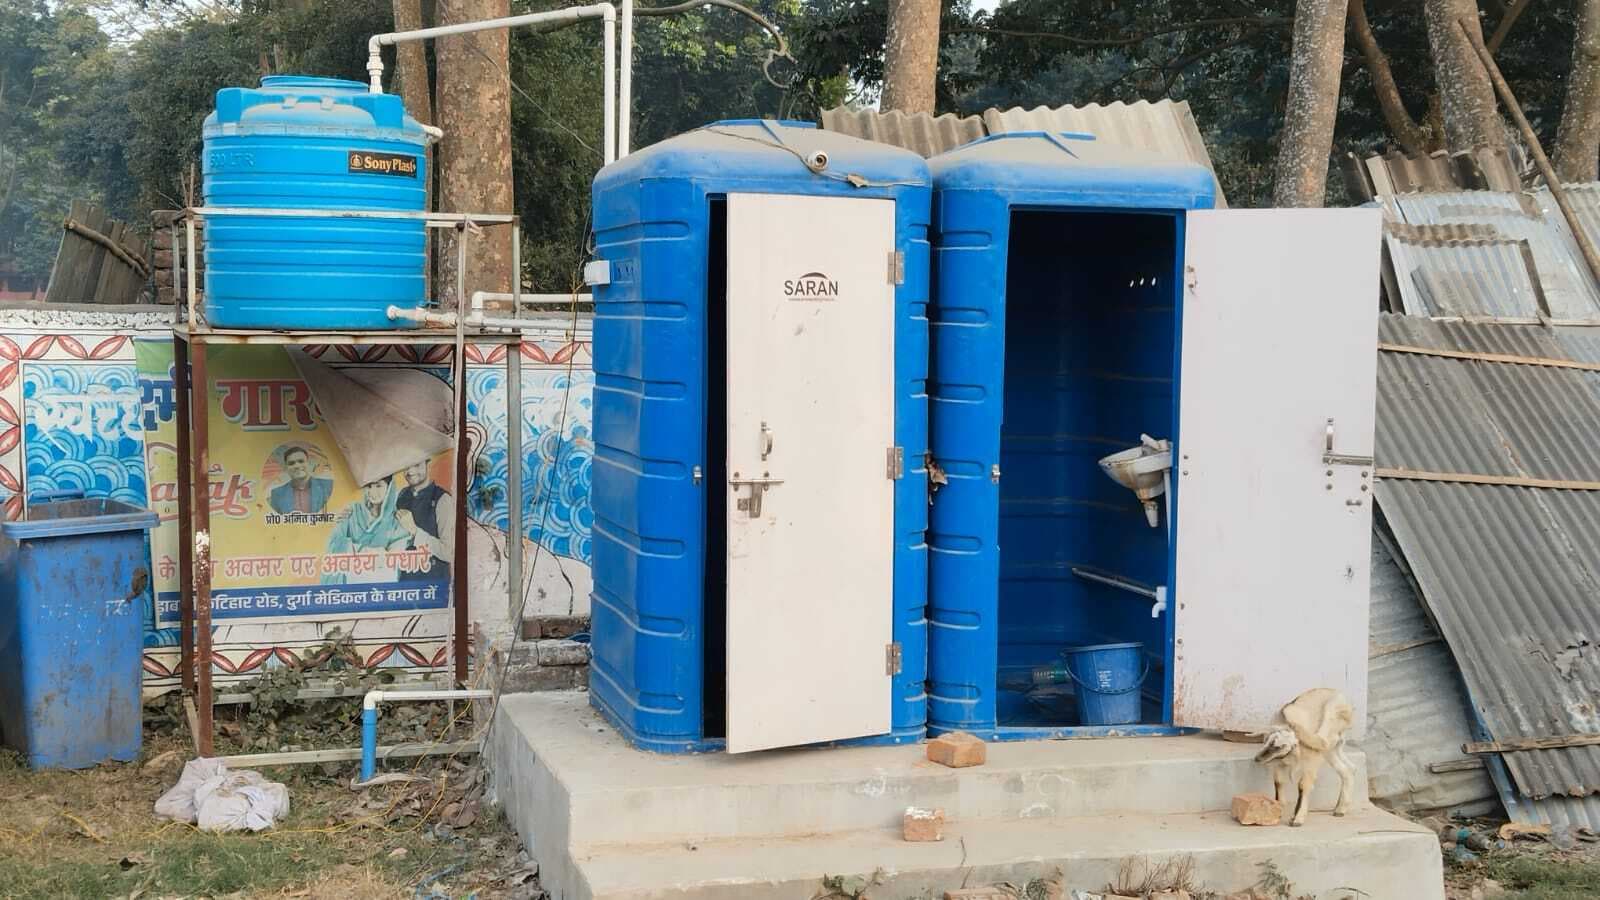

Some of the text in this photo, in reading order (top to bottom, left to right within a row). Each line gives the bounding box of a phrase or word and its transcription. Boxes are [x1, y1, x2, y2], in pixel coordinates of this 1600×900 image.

[784, 280, 838, 296] SARAN
[159, 554, 177, 579] के
[225, 556, 284, 578] अवसर
[289, 556, 317, 578] पर
[323, 553, 379, 575] अवश्य
[384, 544, 432, 574] पधारें
[286, 590, 312, 610] दुर्गा
[314, 588, 368, 606] मेडिकल
[370, 587, 384, 602] के
[386, 588, 420, 602] बगल
[422, 585, 438, 601] में
